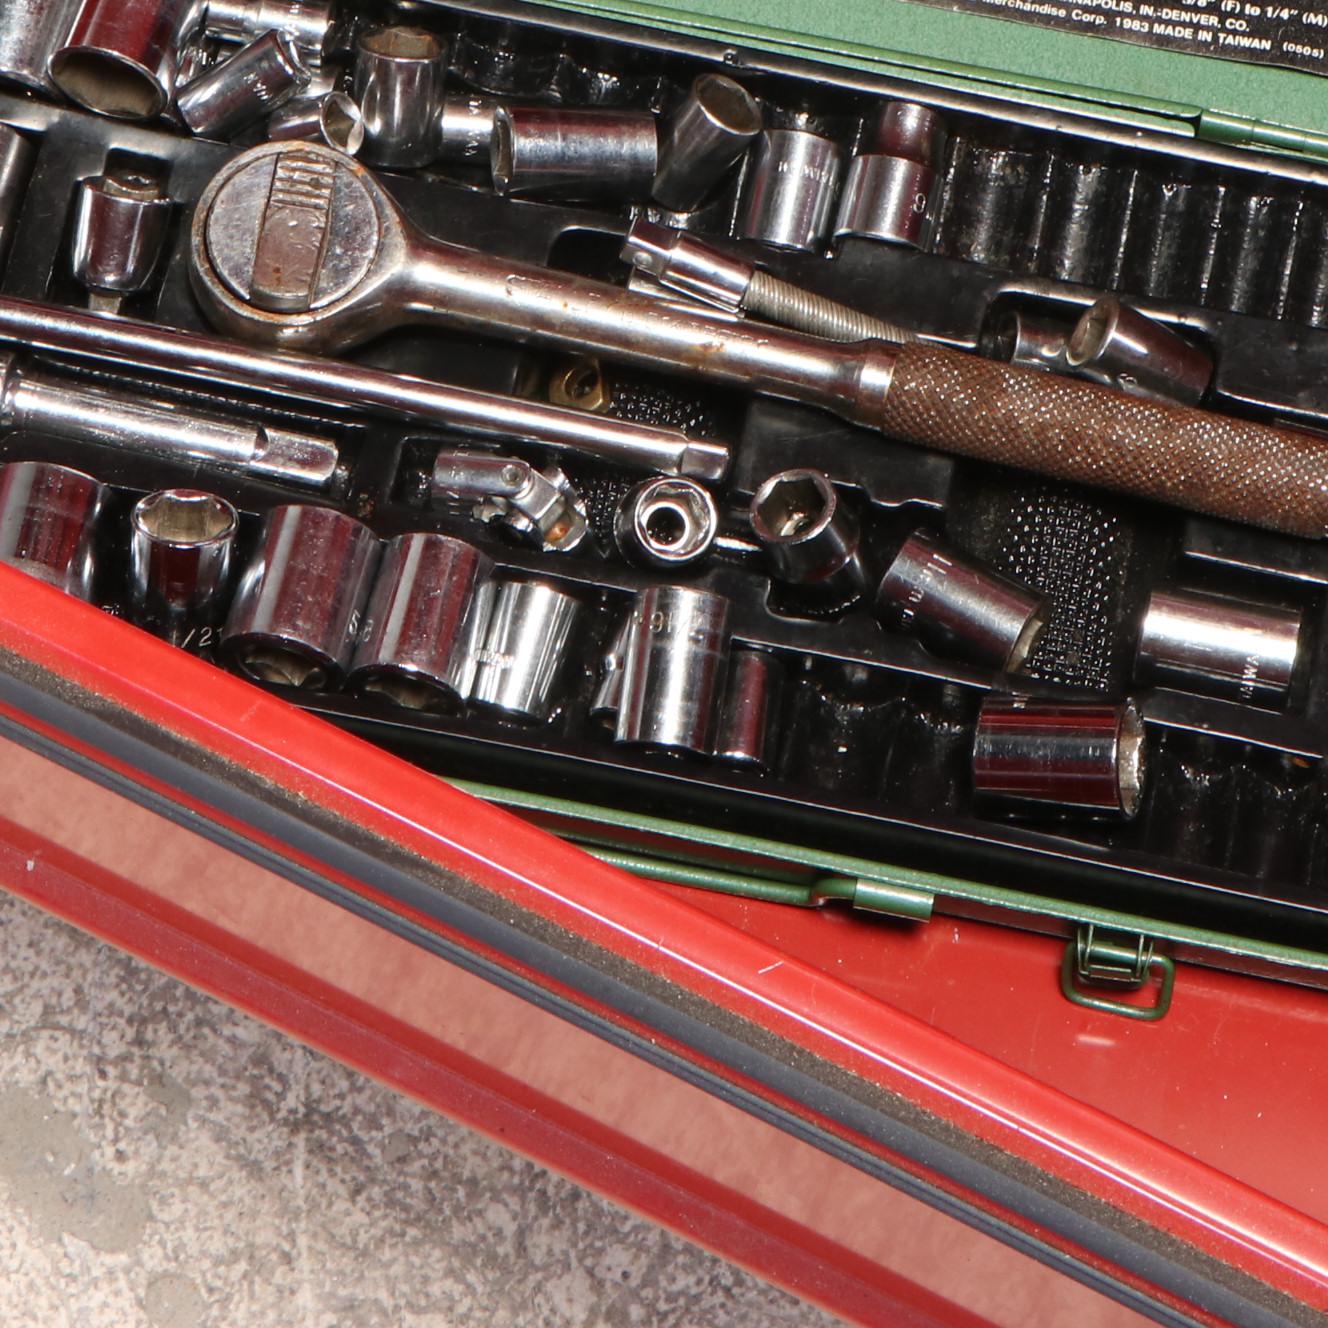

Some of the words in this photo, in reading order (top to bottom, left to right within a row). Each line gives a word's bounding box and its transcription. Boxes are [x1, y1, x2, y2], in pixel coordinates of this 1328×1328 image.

[1225, 17, 1250, 32] CO.
[1244, 2, 1261, 17] to
[1302, 11, 1328, 28] (M)
[1071, 8, 1107, 26] Corp.
[1115, 16, 1150, 33] 1983
[1153, 23, 1193, 40] MADE
[1197, 30, 1214, 42] IN
[1218, 33, 1272, 51] TAIWAN
[1283, 41, 1325, 59] (0505)
